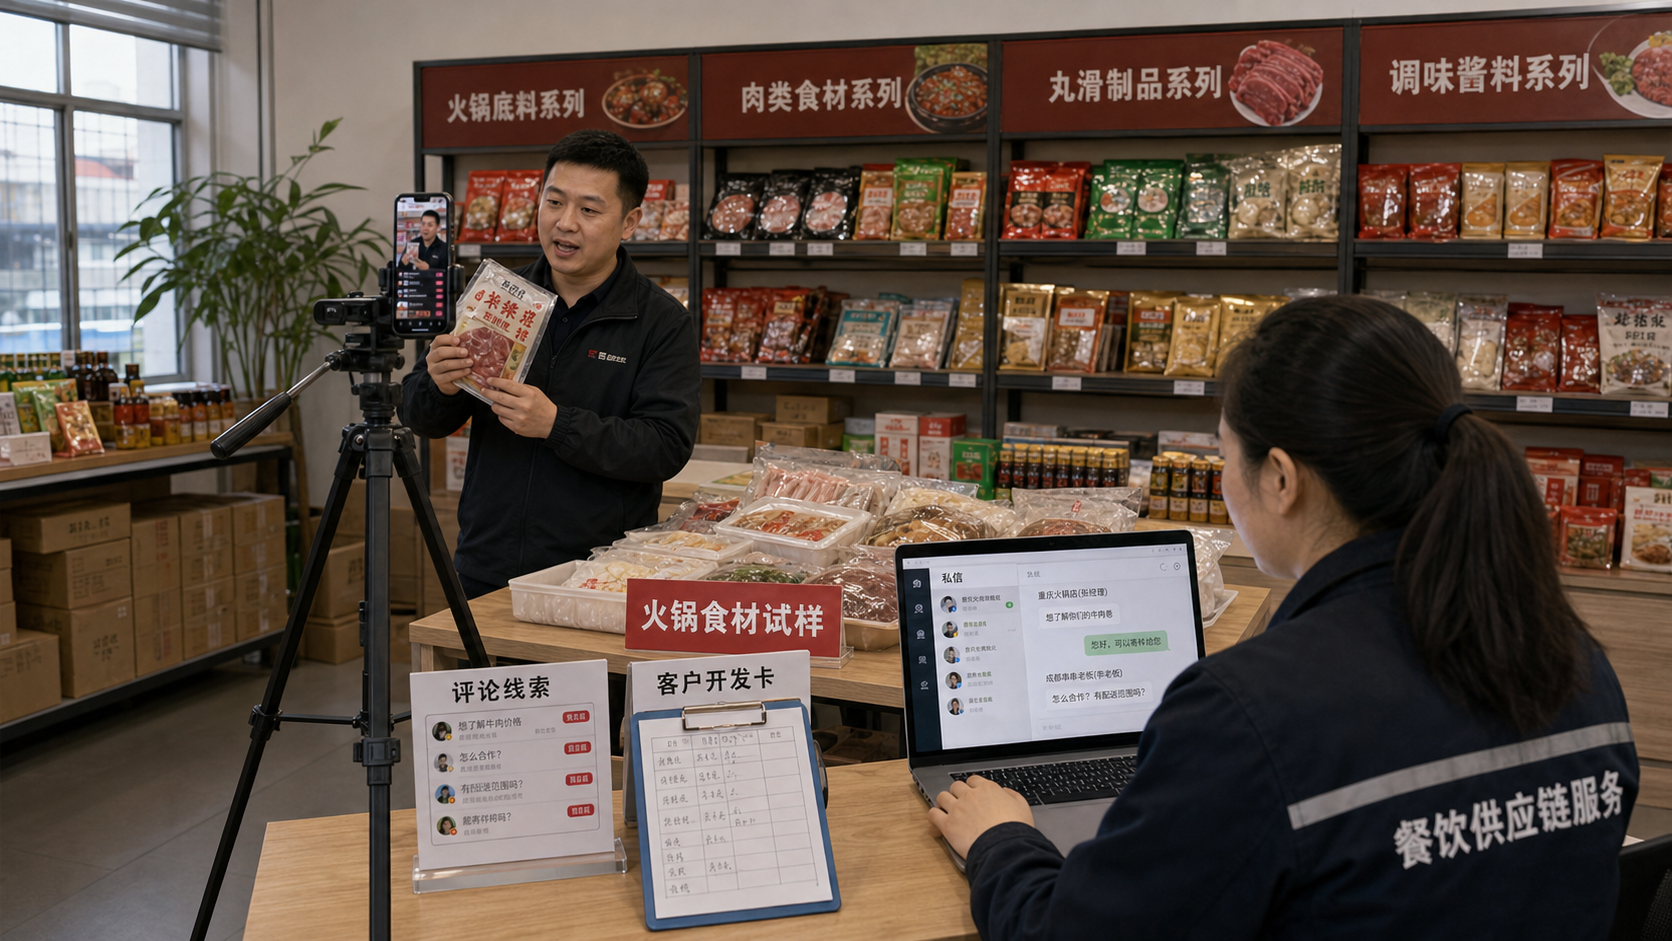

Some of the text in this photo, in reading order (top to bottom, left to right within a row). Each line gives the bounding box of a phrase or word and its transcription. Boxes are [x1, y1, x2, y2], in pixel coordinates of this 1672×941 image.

[1048, 65, 1222, 103] 丸滑制品系列
[1389, 51, 1590, 96] 调味酱料系列
[447, 88, 585, 124] 火锅底料系列
[741, 77, 902, 114] 肉类食材系列
[942, 572, 963, 583] 私信
[641, 599, 823, 637] 火锅食材试样
[452, 676, 550, 704] 评论线索
[657, 665, 775, 696] 客户开发卡
[1393, 770, 1624, 870] 餐饮供应链服务
